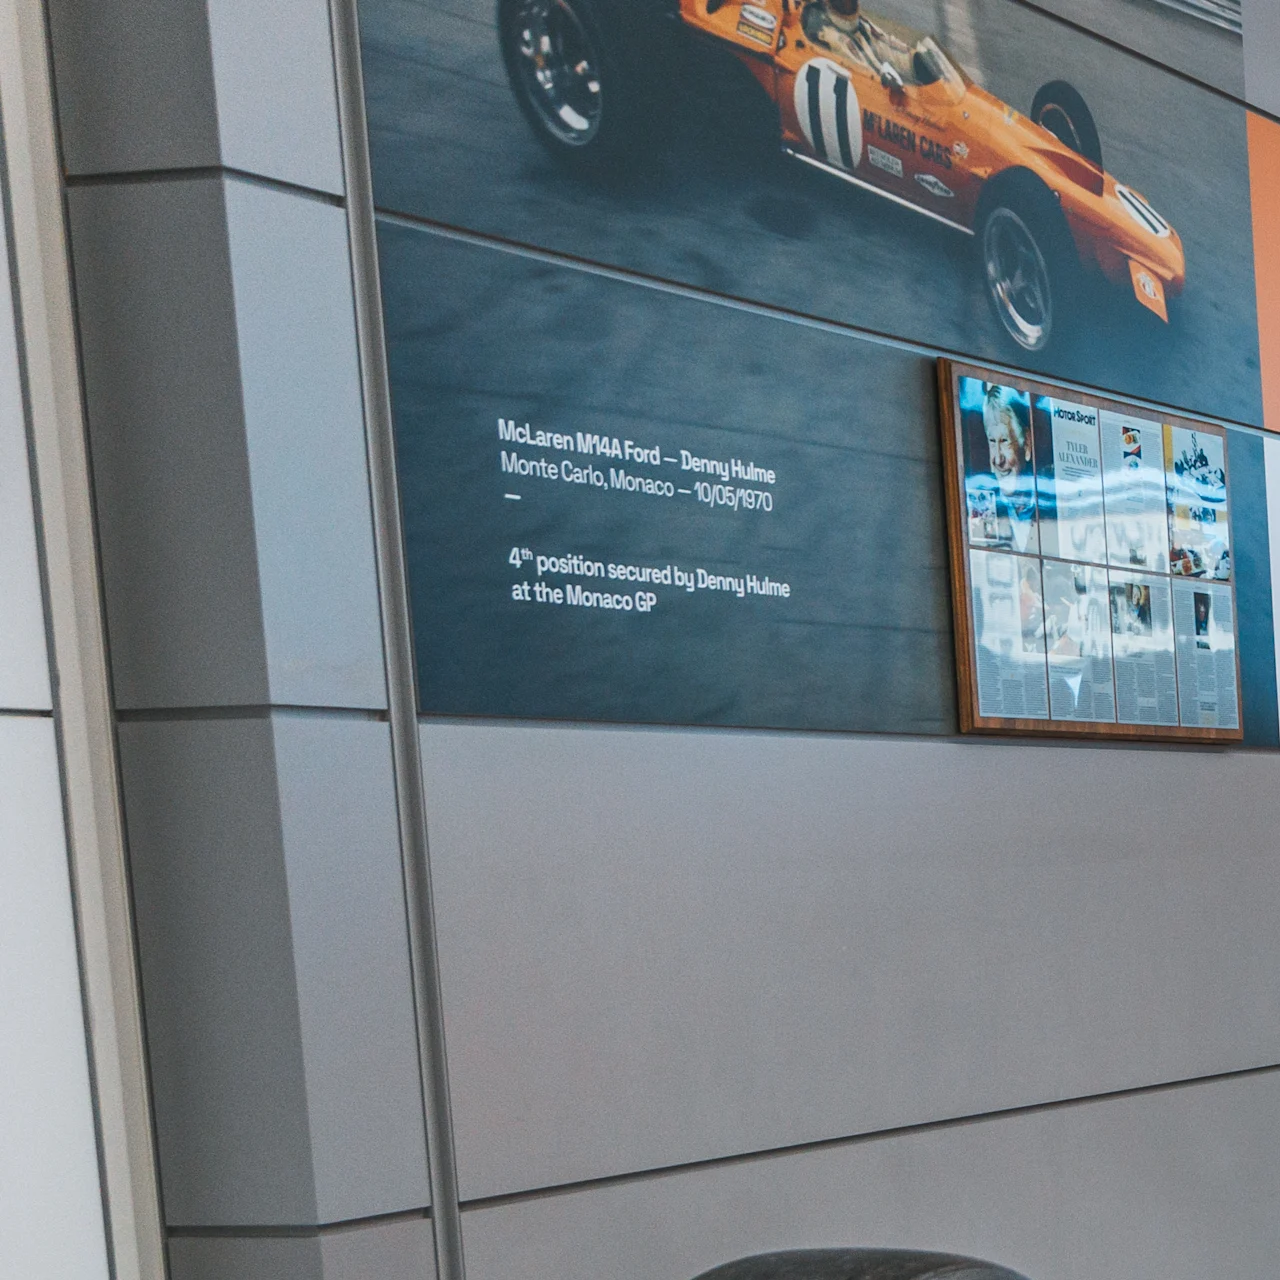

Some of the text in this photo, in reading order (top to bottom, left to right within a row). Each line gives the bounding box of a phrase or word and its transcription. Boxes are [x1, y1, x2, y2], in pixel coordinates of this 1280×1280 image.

[1076, 410, 1096, 426] SPORT
[498, 418, 574, 451] McLaren
[576, 432, 623, 459] M14A
[625, 441, 660, 465] Ford
[680, 450, 730, 481] Denny
[731, 459, 776, 484] Hulme
[1059, 452, 1098, 469] ALEXANDER
[1066, 441, 1088, 454] TYLER
[500, 450, 558, 480] Monte
[561, 460, 608, 490] Carlo,
[610, 468, 674, 497] Monaco
[694, 481, 773, 512] 10/05/1970
[536, 553, 605, 577] position
[608, 565, 671, 586] secured
[673, 566, 695, 592] by
[696, 568, 744, 597] Denny
[746, 575, 791, 598] Hulme
[512, 582, 657, 612] at the Monaco GP
